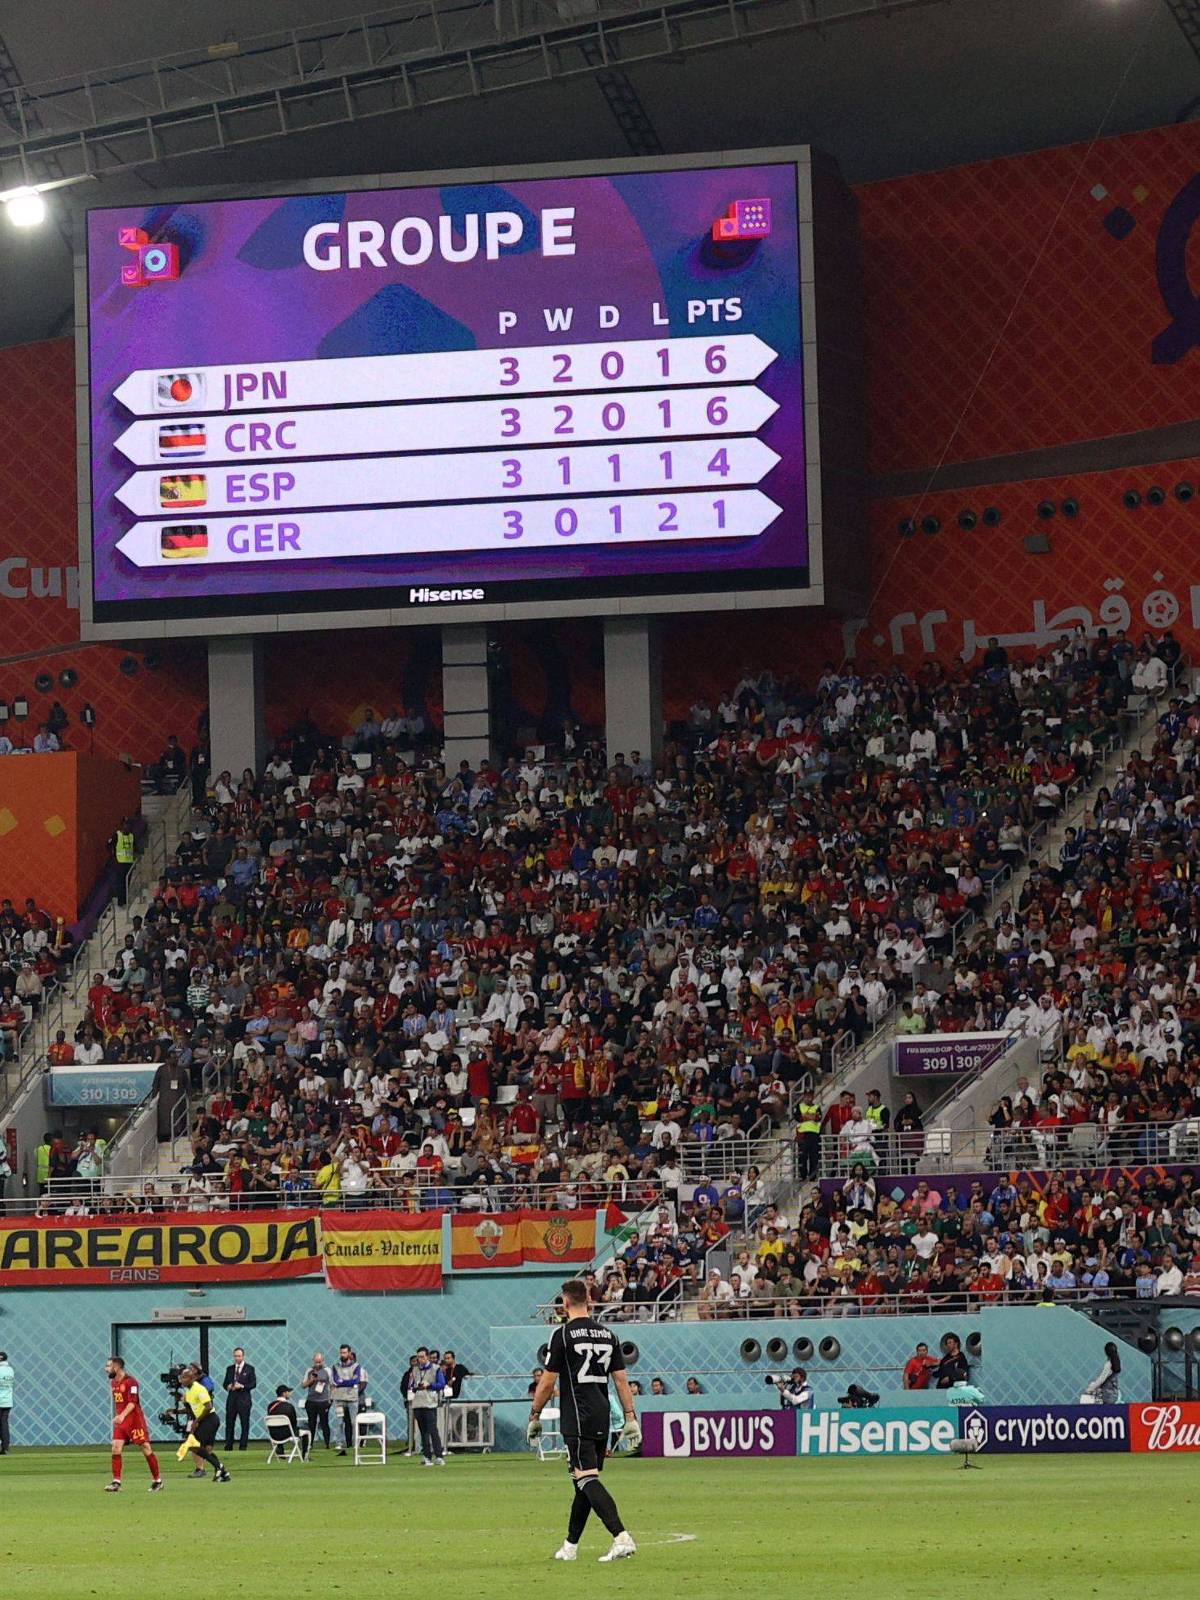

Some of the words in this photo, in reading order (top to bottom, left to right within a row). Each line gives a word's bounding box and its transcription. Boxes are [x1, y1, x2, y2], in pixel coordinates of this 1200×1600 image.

[303, 211, 523, 271] GROUP
[541, 207, 577, 257] E
[498, 311, 517, 335] P
[543, 307, 574, 332] W
[599, 305, 620, 329] D
[652, 302, 670, 326] L
[687, 297, 742, 324] PTS
[223, 371, 288, 411] JPN
[499, 357, 521, 387] 3
[552, 353, 574, 384] 2
[600, 350, 625, 381] 0
[656, 347, 670, 378] 1
[704, 344, 727, 375] 6
[224, 420, 297, 453] CRC
[500, 407, 522, 438] 3
[553, 404, 575, 435] 2
[601, 401, 626, 432] 0
[657, 398, 672, 429] 1
[706, 395, 729, 426] 6
[225, 472, 296, 504] ESP
[501, 458, 523, 489] 3
[557, 455, 571, 486] 1
[607, 453, 621, 483] 1
[659, 450, 673, 480] 1
[707, 447, 731, 477] 4
[226, 522, 302, 555] GER
[503, 509, 524, 540] 3
[554, 506, 579, 537] 0
[608, 504, 622, 534] 1
[657, 501, 679, 532] 2
[712, 499, 726, 529] 1
[409, 588, 485, 603] Hisense
[110, 1268, 160, 1282] FANS
[573, 1342, 614, 1384] 23
[693, 1415, 775, 1451] BYJU'S
[801, 1412, 955, 1454] Hisense
[994, 1413, 1126, 1447] crypto.com
